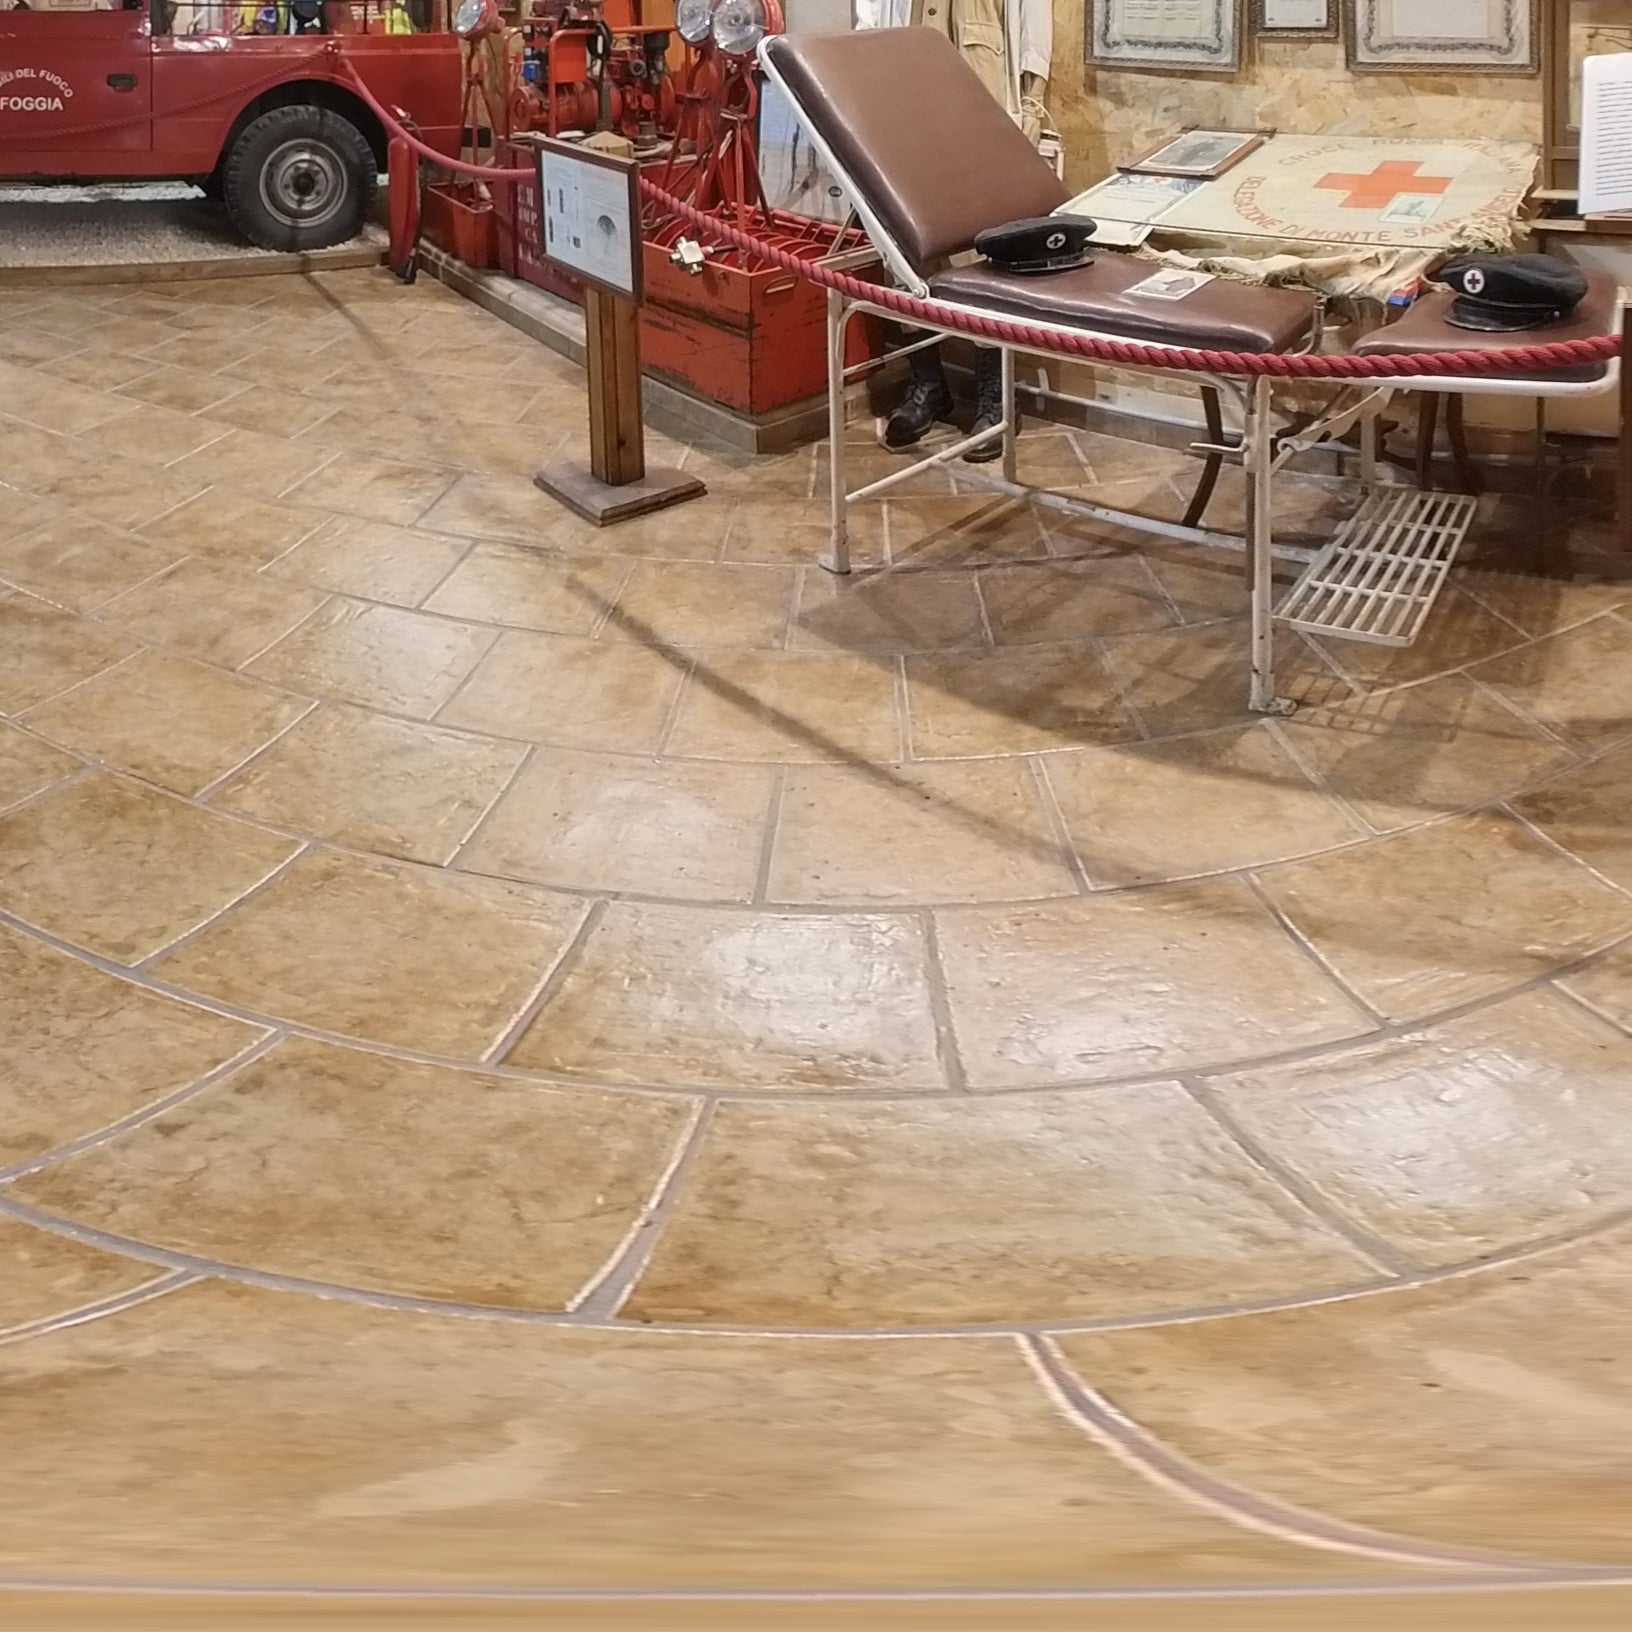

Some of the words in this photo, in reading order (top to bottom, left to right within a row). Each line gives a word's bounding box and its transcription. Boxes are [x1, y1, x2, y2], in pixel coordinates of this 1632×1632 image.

[15, 68, 37, 79] DEL
[39, 69, 73, 98] FUOCO
[0, 96, 64, 111] FOGGIA
[1278, 141, 1353, 166] CROCE
[1305, 228, 1392, 242] MONTE
